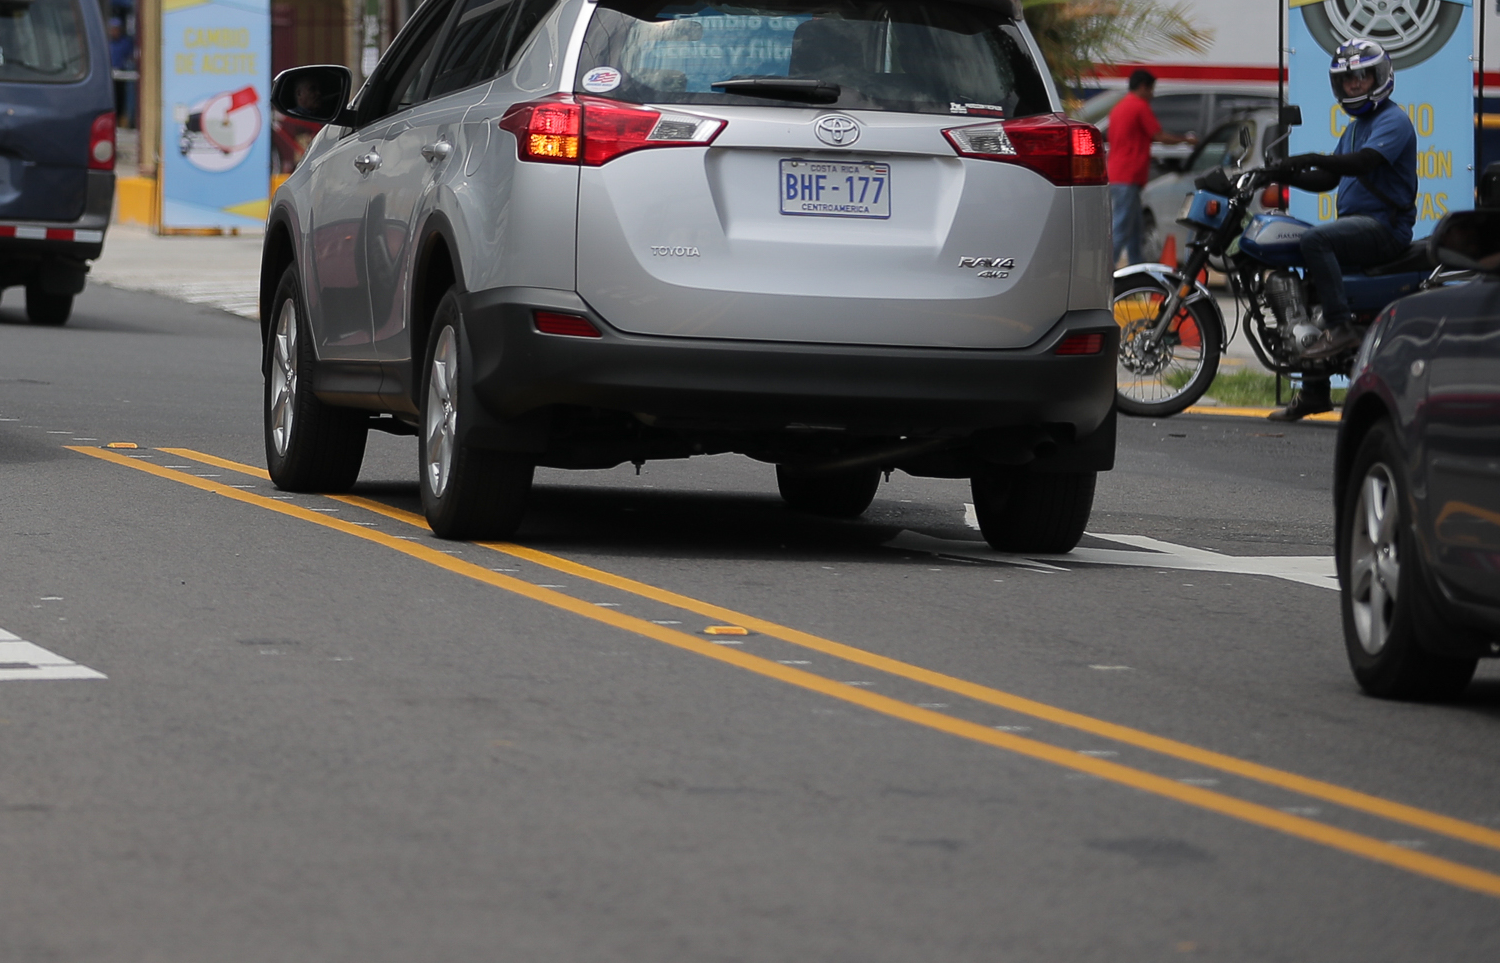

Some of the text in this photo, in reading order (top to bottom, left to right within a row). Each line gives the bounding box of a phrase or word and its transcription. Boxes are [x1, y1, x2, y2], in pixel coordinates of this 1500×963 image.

[183, 26, 250, 49] CAMBIO
[175, 52, 258, 75] DE ACEITE
[1330, 103, 1434, 138] CIO
[810, 164, 860, 174] COSTA RICA
[801, 203, 870, 213] CENTROAMERICA
[650, 245, 701, 257] TOYOTA
[958, 256, 1015, 269] RAV4
